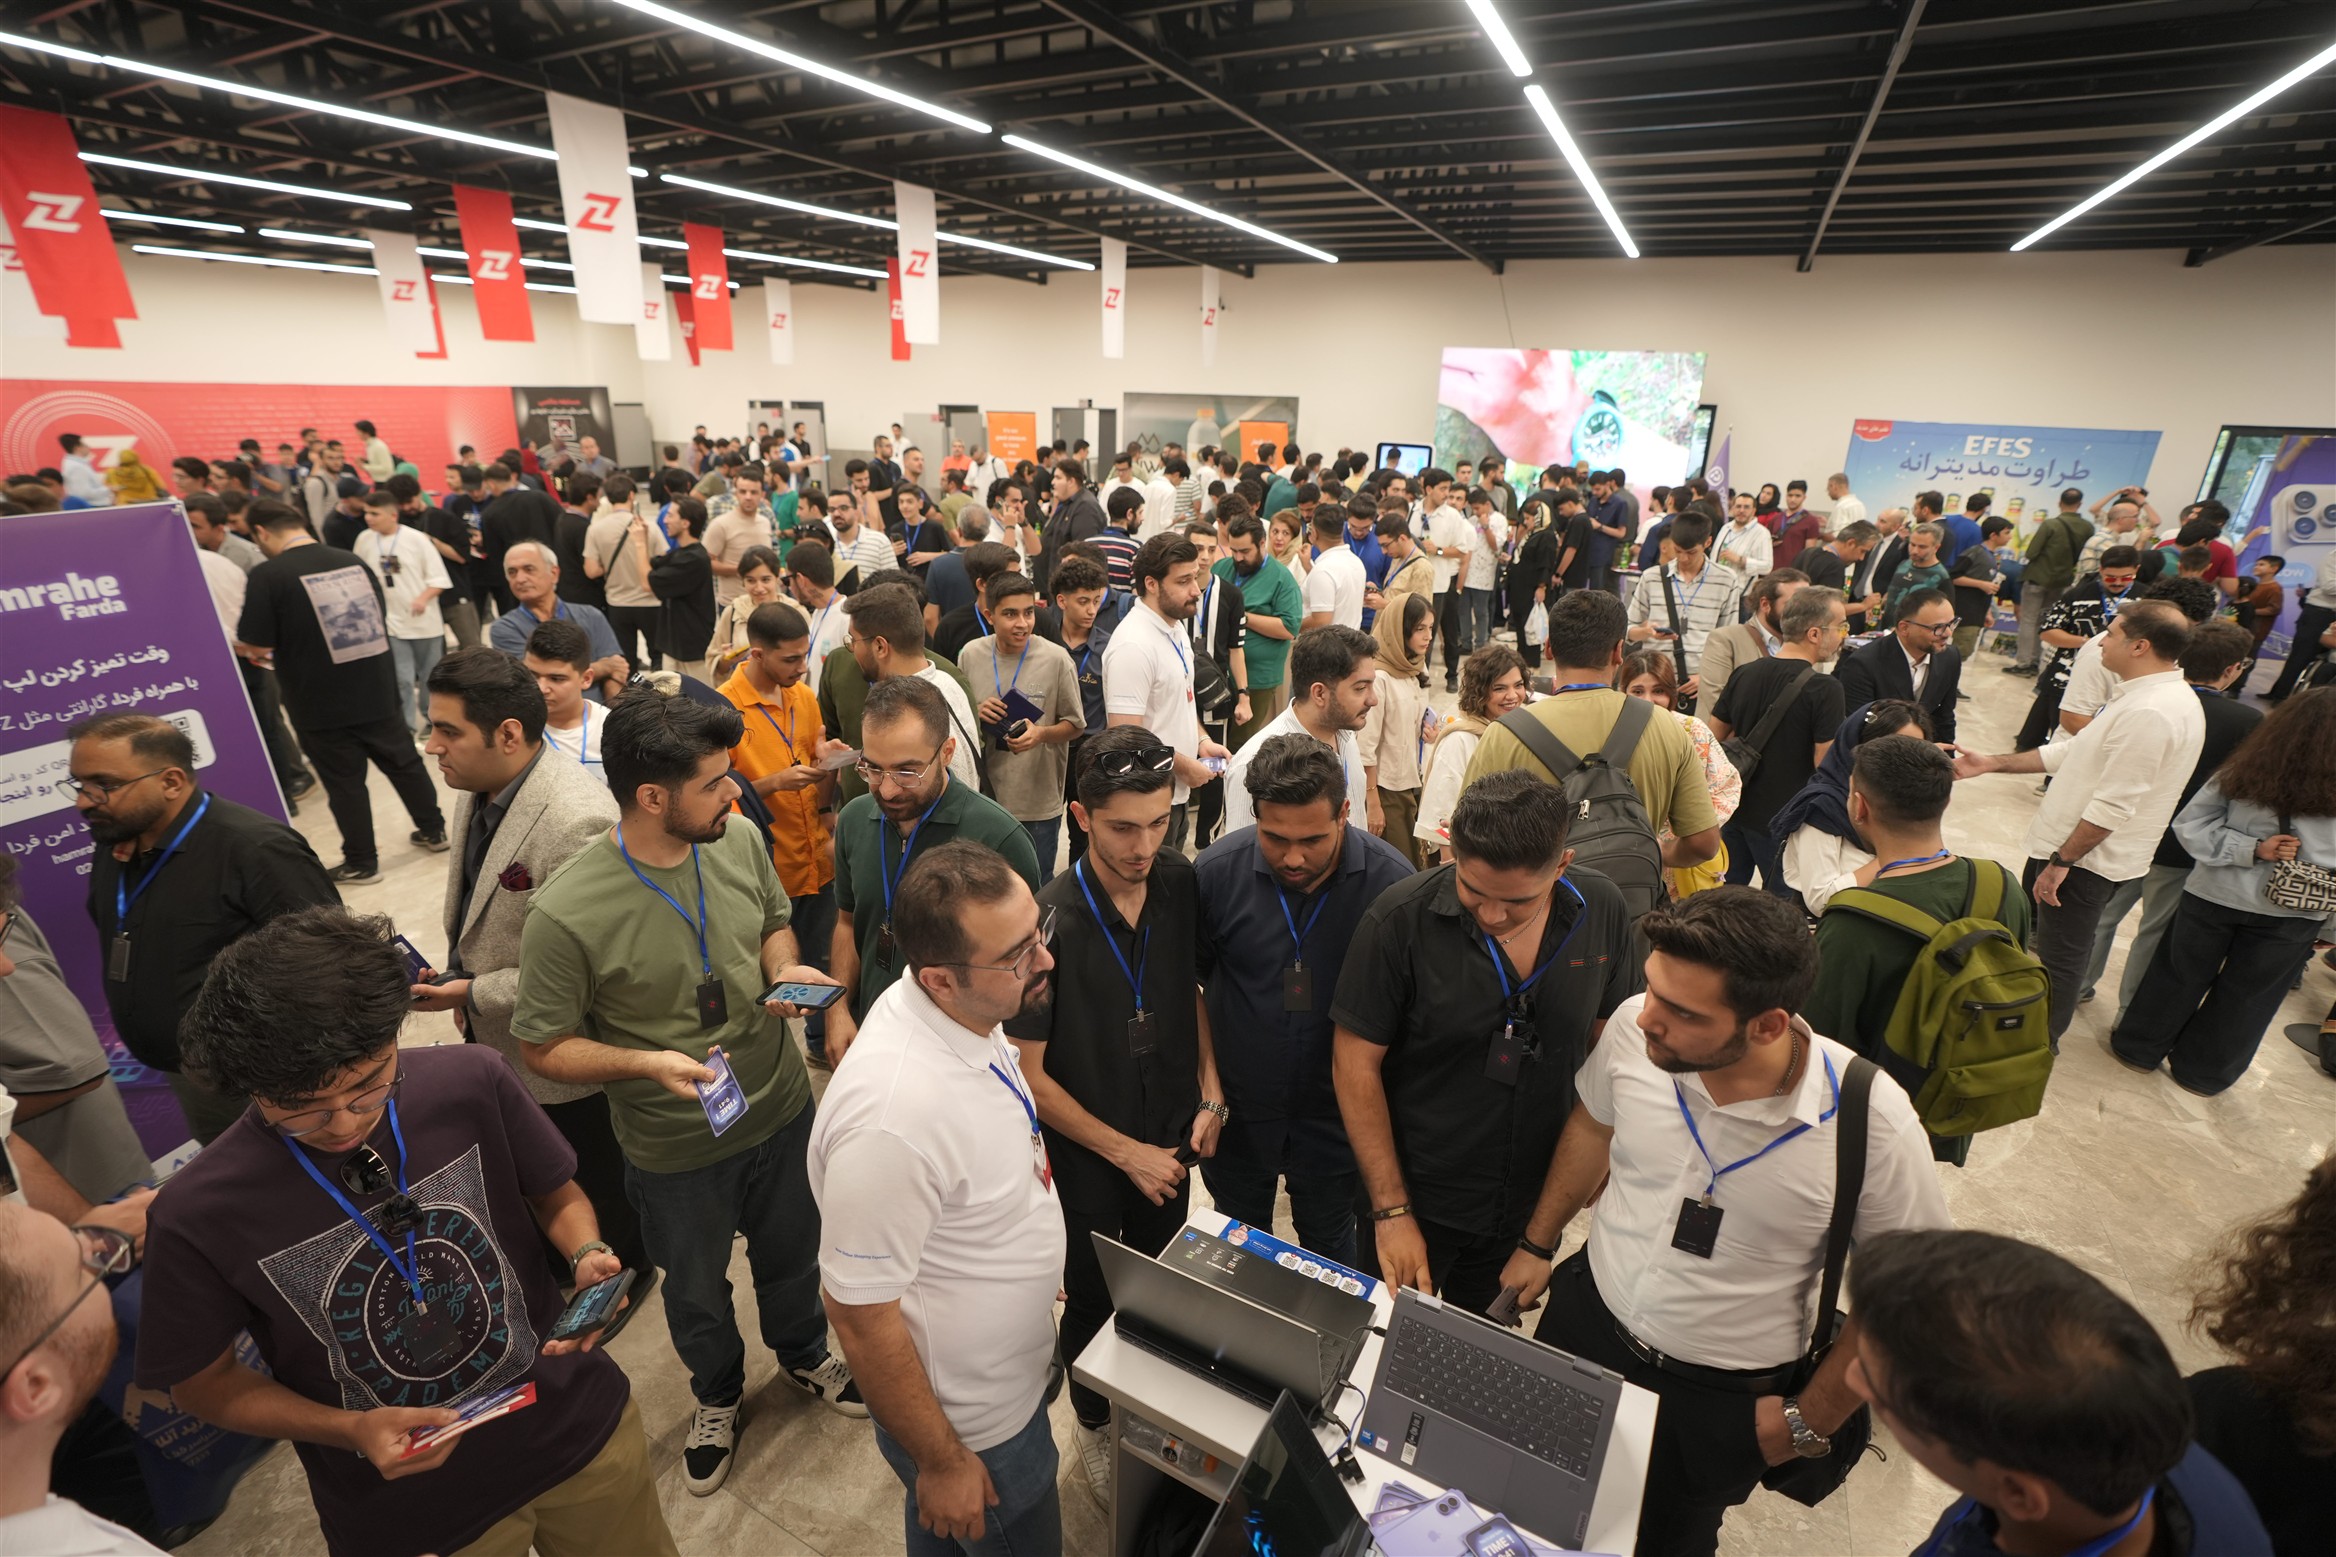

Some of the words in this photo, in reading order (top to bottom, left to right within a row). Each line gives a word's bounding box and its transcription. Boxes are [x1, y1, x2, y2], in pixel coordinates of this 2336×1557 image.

[1963, 434, 2034, 459] EFES
[1899, 452, 2000, 481] مدیترانه
[2004, 457, 2091, 488] طراوت
[0, 572, 121, 613] mrahe
[59, 598, 128, 621] Farda
[89, 653, 127, 678] تمیز
[128, 645, 170, 664] وقت
[3, 669, 37, 693] لپ
[40, 659, 86, 687] کردن
[184, 676, 199, 690] با
[145, 681, 186, 700] همراه
[19, 710, 53, 731] مثل
[0, 773, 17, 785] اس
[37, 784, 52, 797] رو
[0, 784, 33, 804] اینج
[6, 834, 41, 855] فردا
[44, 823, 76, 847] امن
[76, 863, 93, 876] 02
[441, 1252, 460, 1270] MADE
[332, 1211, 489, 1342] REGIERED
[379, 1272, 394, 1317] COTTON
[1576, 1514, 1588, 1540] Lenovo
[1482, 1535, 1511, 1557] TIME
